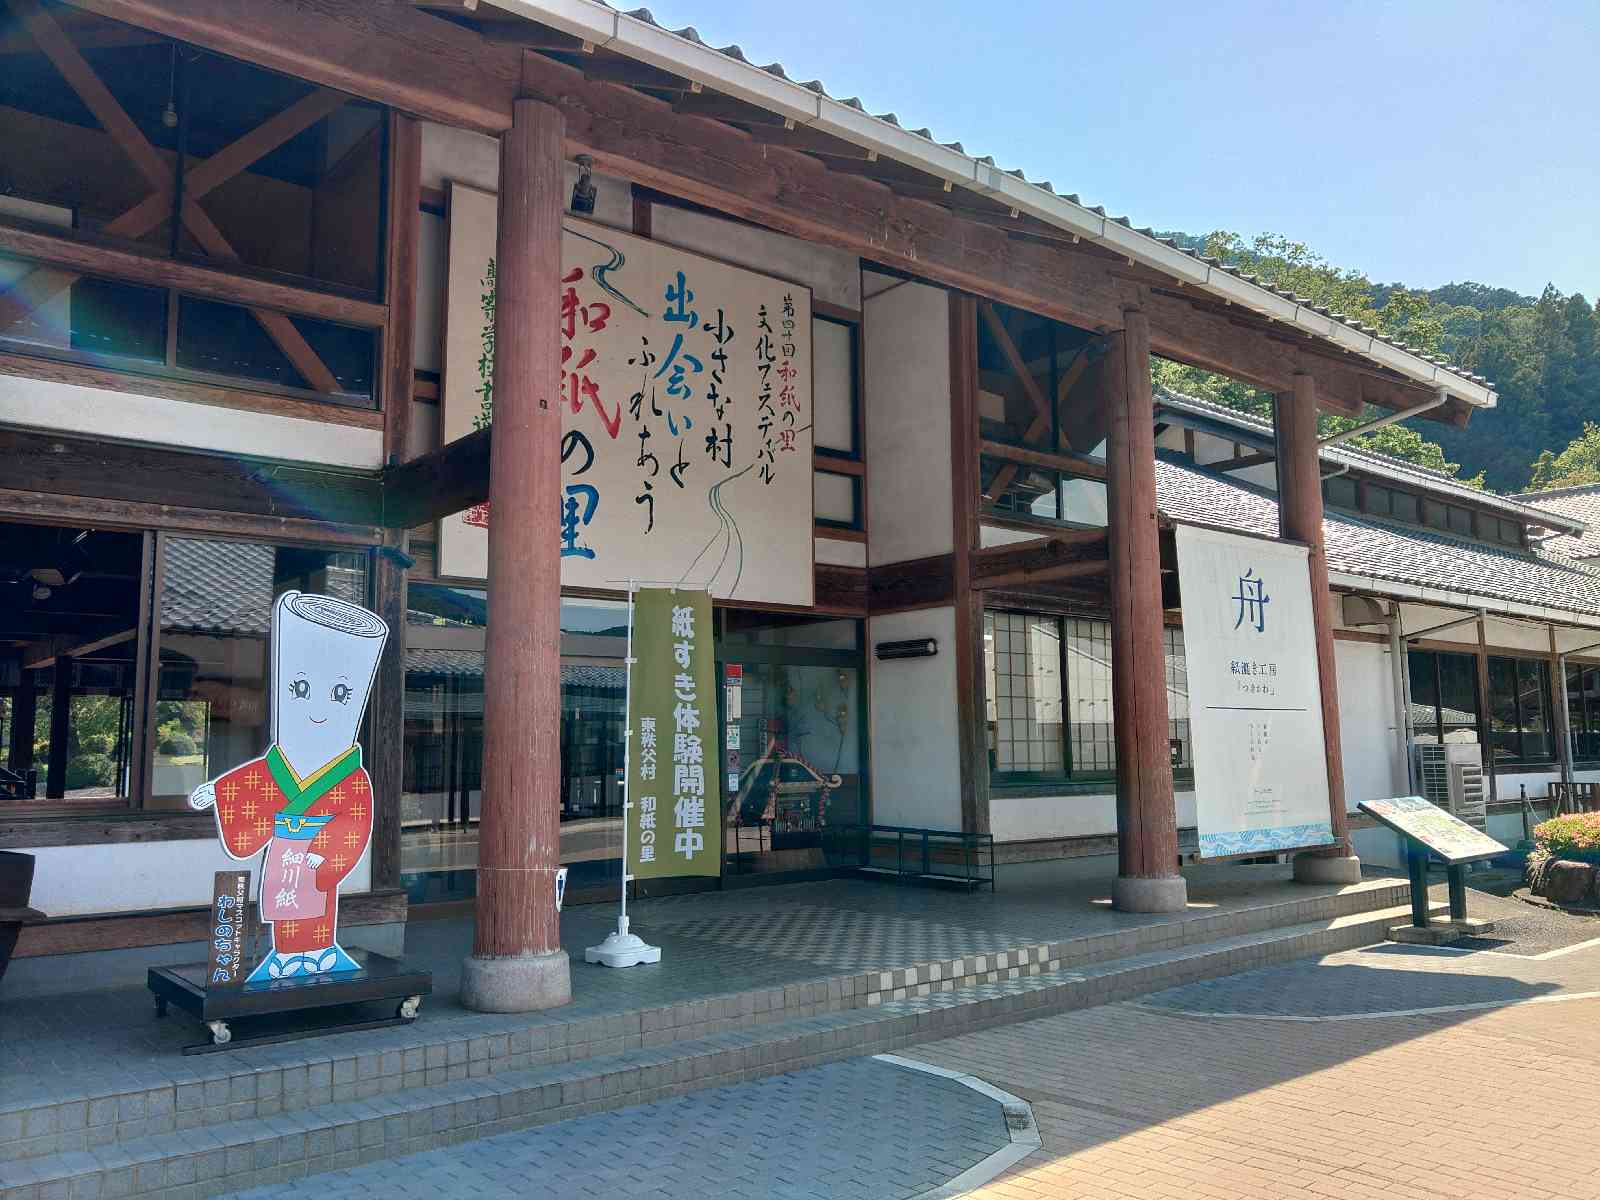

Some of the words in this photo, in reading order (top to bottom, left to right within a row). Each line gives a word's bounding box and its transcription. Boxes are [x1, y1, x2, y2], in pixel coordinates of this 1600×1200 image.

[629, 337, 662, 534] ふれあう
[657, 272, 703, 488] 出会いと
[704, 310, 734, 468] 小さな村
[755, 305, 776, 484] 文化フェスティバル
[1232, 568, 1270, 632] 舟
[640, 717, 656, 780] 東秩父村
[672, 606, 704, 860] 紙すき体験開催中
[275, 849, 304, 909] 細川紙
[640, 797, 656, 862] 和紙の里
[212, 894, 236, 984] わしのちゃん
